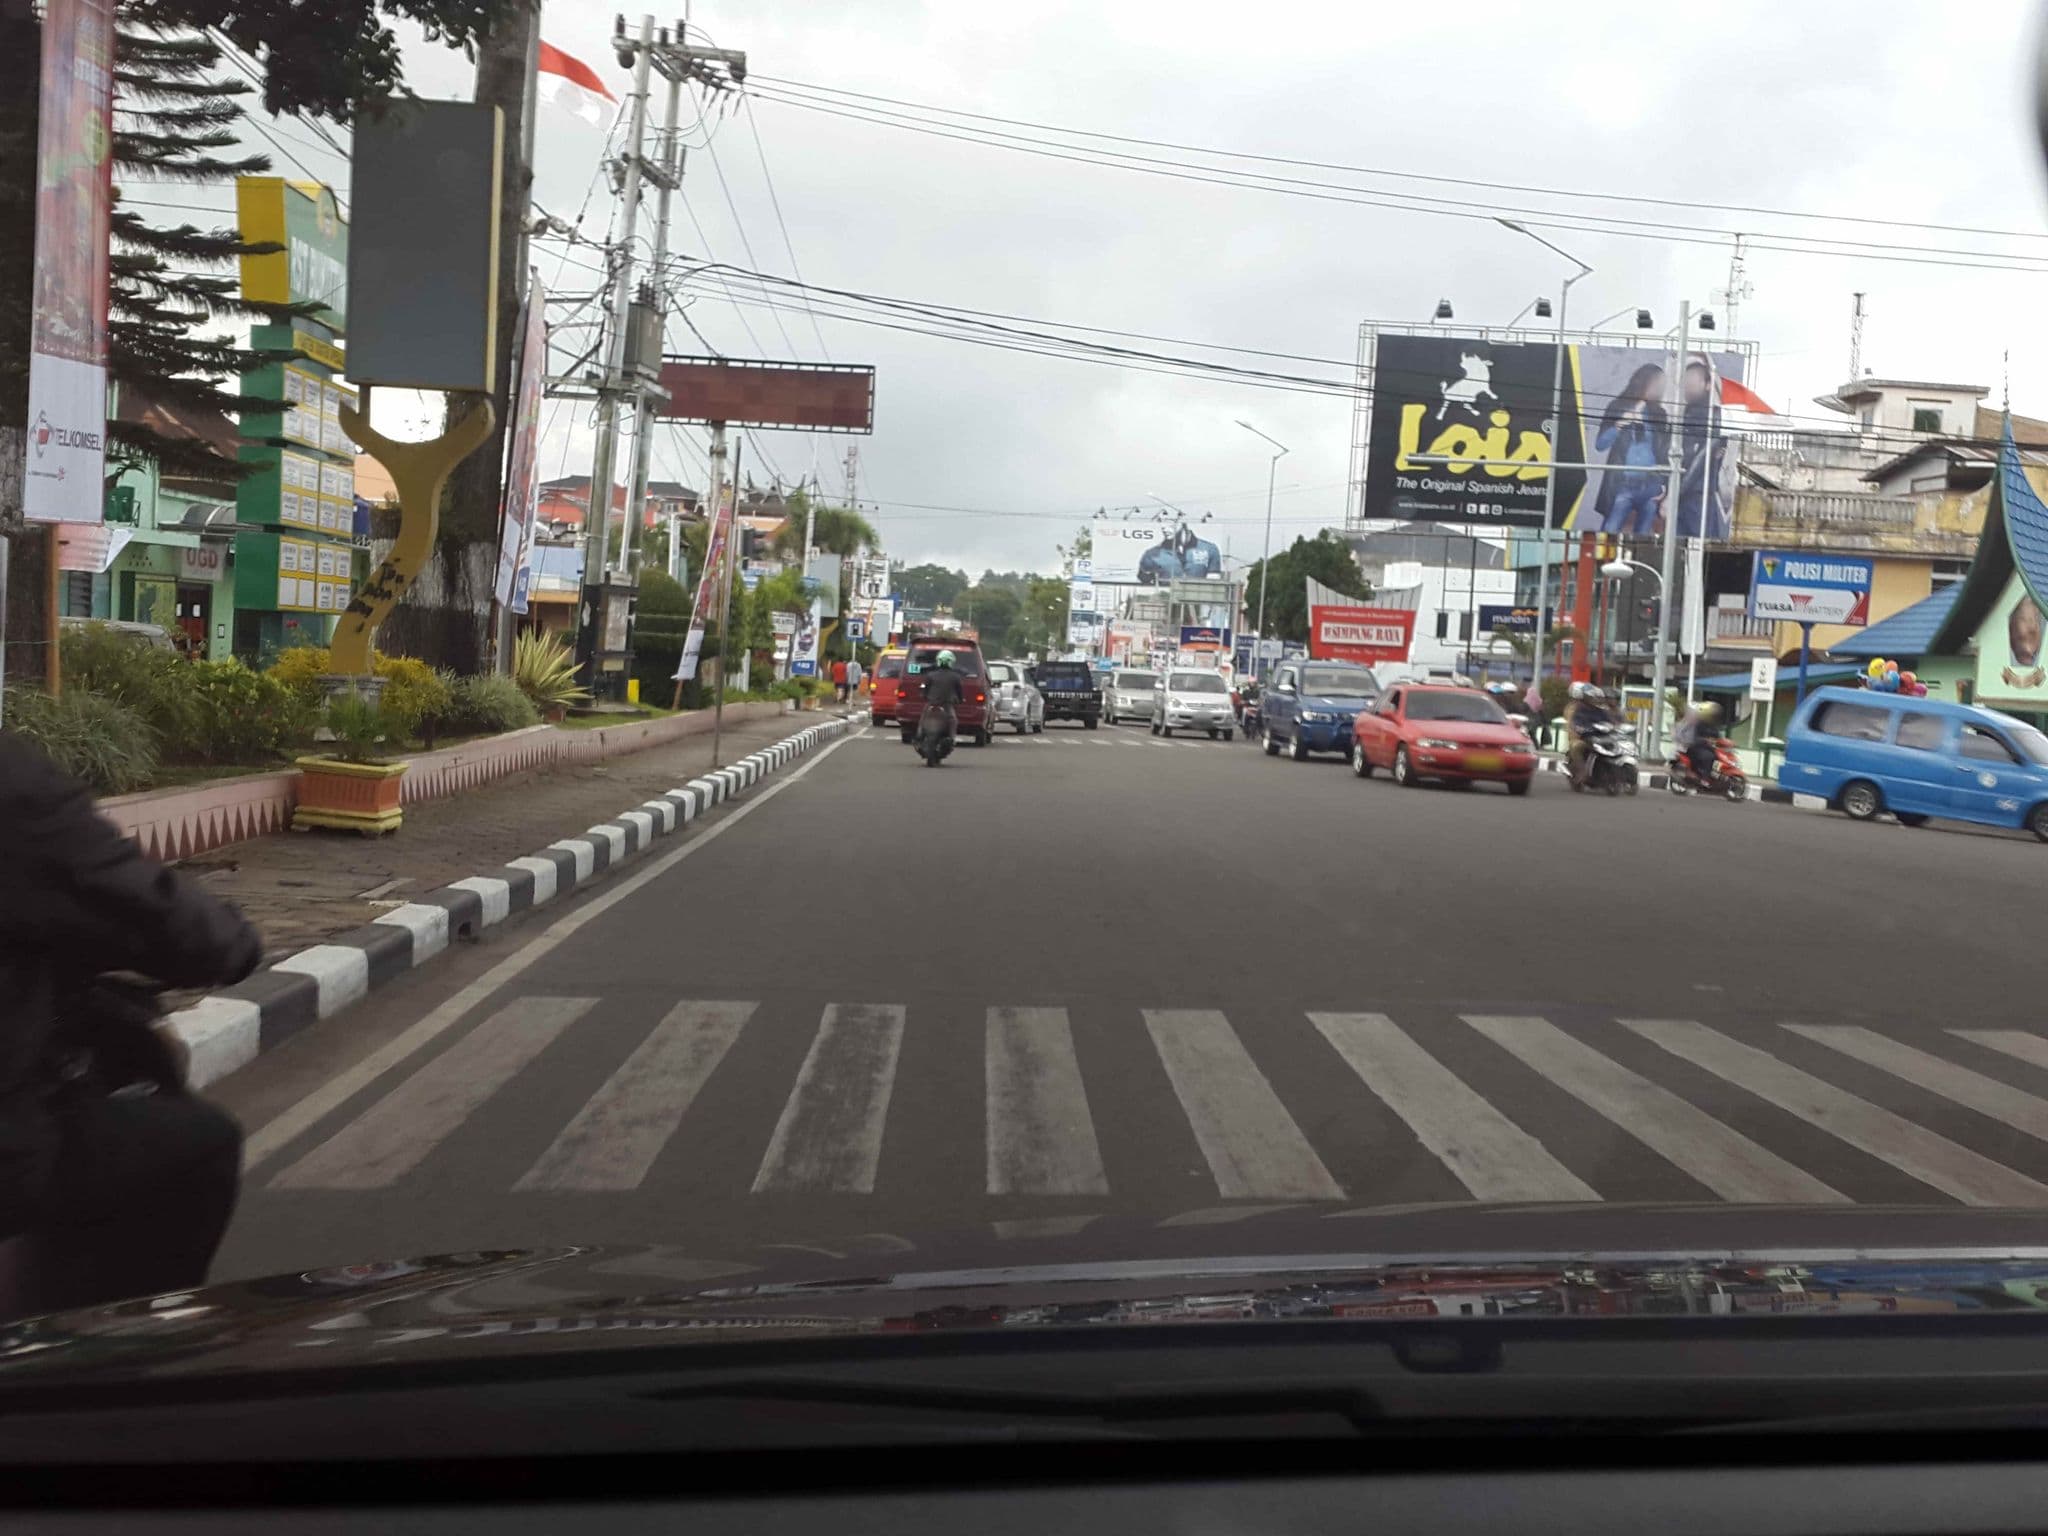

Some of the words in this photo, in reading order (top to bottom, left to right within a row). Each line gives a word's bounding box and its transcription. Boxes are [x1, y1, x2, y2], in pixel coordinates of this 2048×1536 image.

[55, 428, 101, 451] TELKOMSEL
[1395, 404, 1552, 480] Lois
[1396, 476, 1418, 490] The
[1420, 478, 1464, 494] Original
[1467, 480, 1514, 496] Spanish
[1122, 529, 1154, 540] LGS
[186, 548, 218, 569] UGD
[1785, 561, 1821, 581] POLISI
[1822, 564, 1868, 584] MILITER
[1757, 602, 1792, 612] YUASA
[1332, 626, 1374, 641] SIMPANG
[1375, 628, 1400, 642] RAYA
